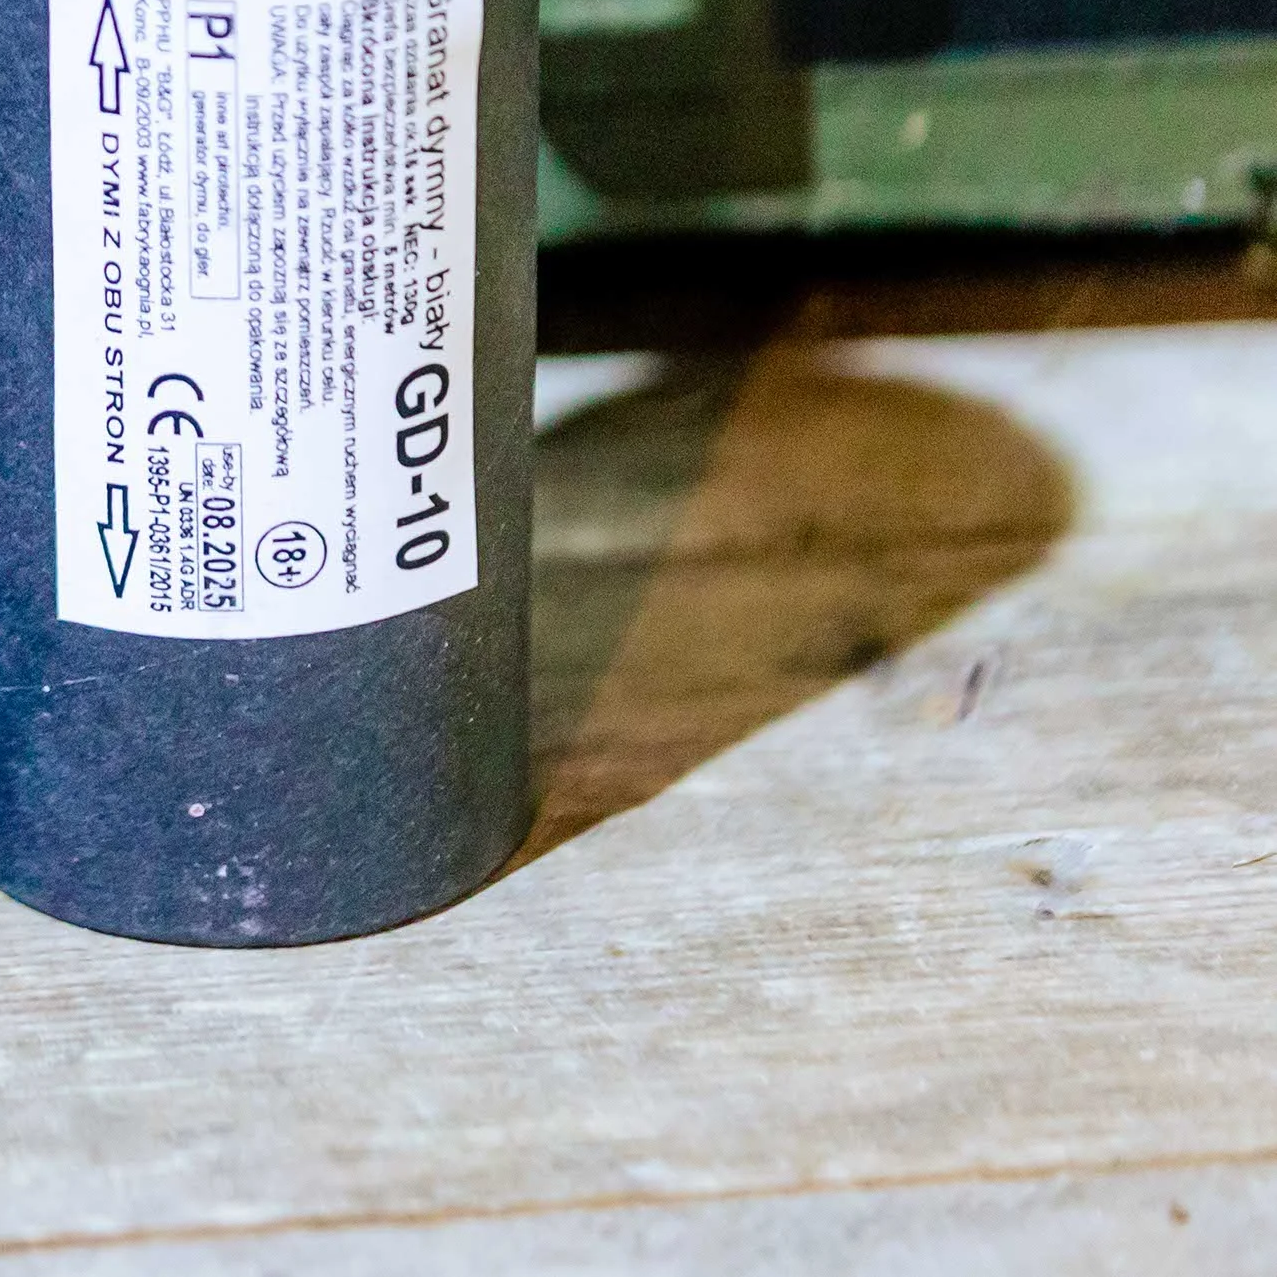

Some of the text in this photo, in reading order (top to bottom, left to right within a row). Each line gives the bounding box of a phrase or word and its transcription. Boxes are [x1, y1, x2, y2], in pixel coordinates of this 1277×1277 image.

[187, 12, 237, 61] P1
[134, 56, 152, 149] B-09/2003
[192, 89, 207, 166] generator
[216, 90, 233, 125] inne
[297, 188, 310, 209] na
[420, 115, 452, 231] dymny
[196, 222, 210, 243] do
[247, 279, 265, 302] do
[269, 227, 288, 304] zapoznaj
[321, 269, 334, 283] w
[101, 131, 125, 464] DYMI Z OBU STRON
[160, 311, 176, 332] 31
[321, 289, 337, 361] kierunku
[401, 278, 419, 326] 130g
[420, 268, 451, 351] biały
[273, 340, 288, 361] ze
[340, 324, 358, 431] energicznym
[178, 481, 195, 503] UN
[344, 437, 359, 500] ruchem
[396, 363, 451, 570] GD-10
[146, 445, 173, 613] 1395-P1-0361/2015
[202, 496, 237, 609] 08.2025
[272, 530, 307, 583] 18+
[179, 578, 196, 611] ADR
